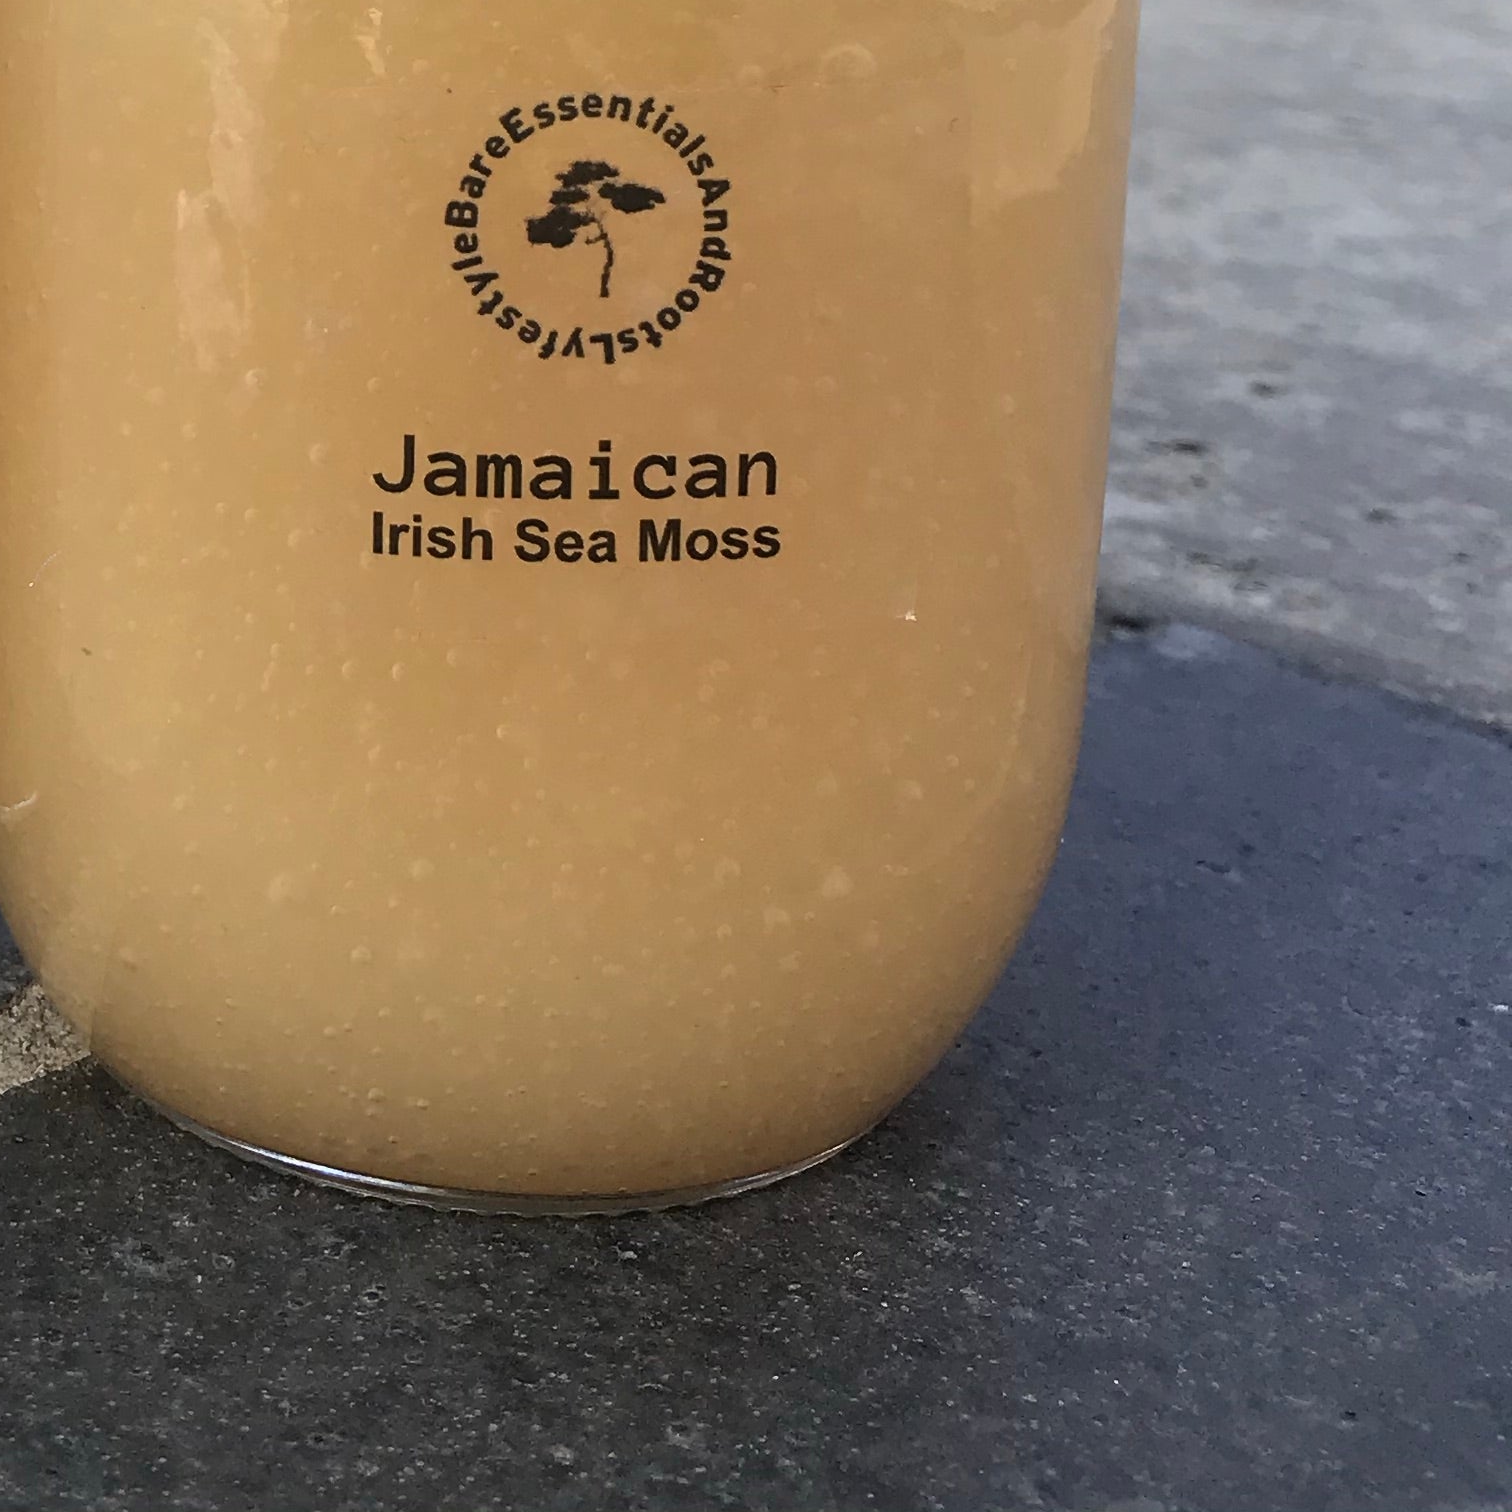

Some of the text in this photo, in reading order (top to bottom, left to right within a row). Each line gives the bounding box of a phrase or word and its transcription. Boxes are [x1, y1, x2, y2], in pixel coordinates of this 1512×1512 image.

[372, 434, 777, 500] Jamaican
[372, 511, 781, 564] Irish Sea Moss
